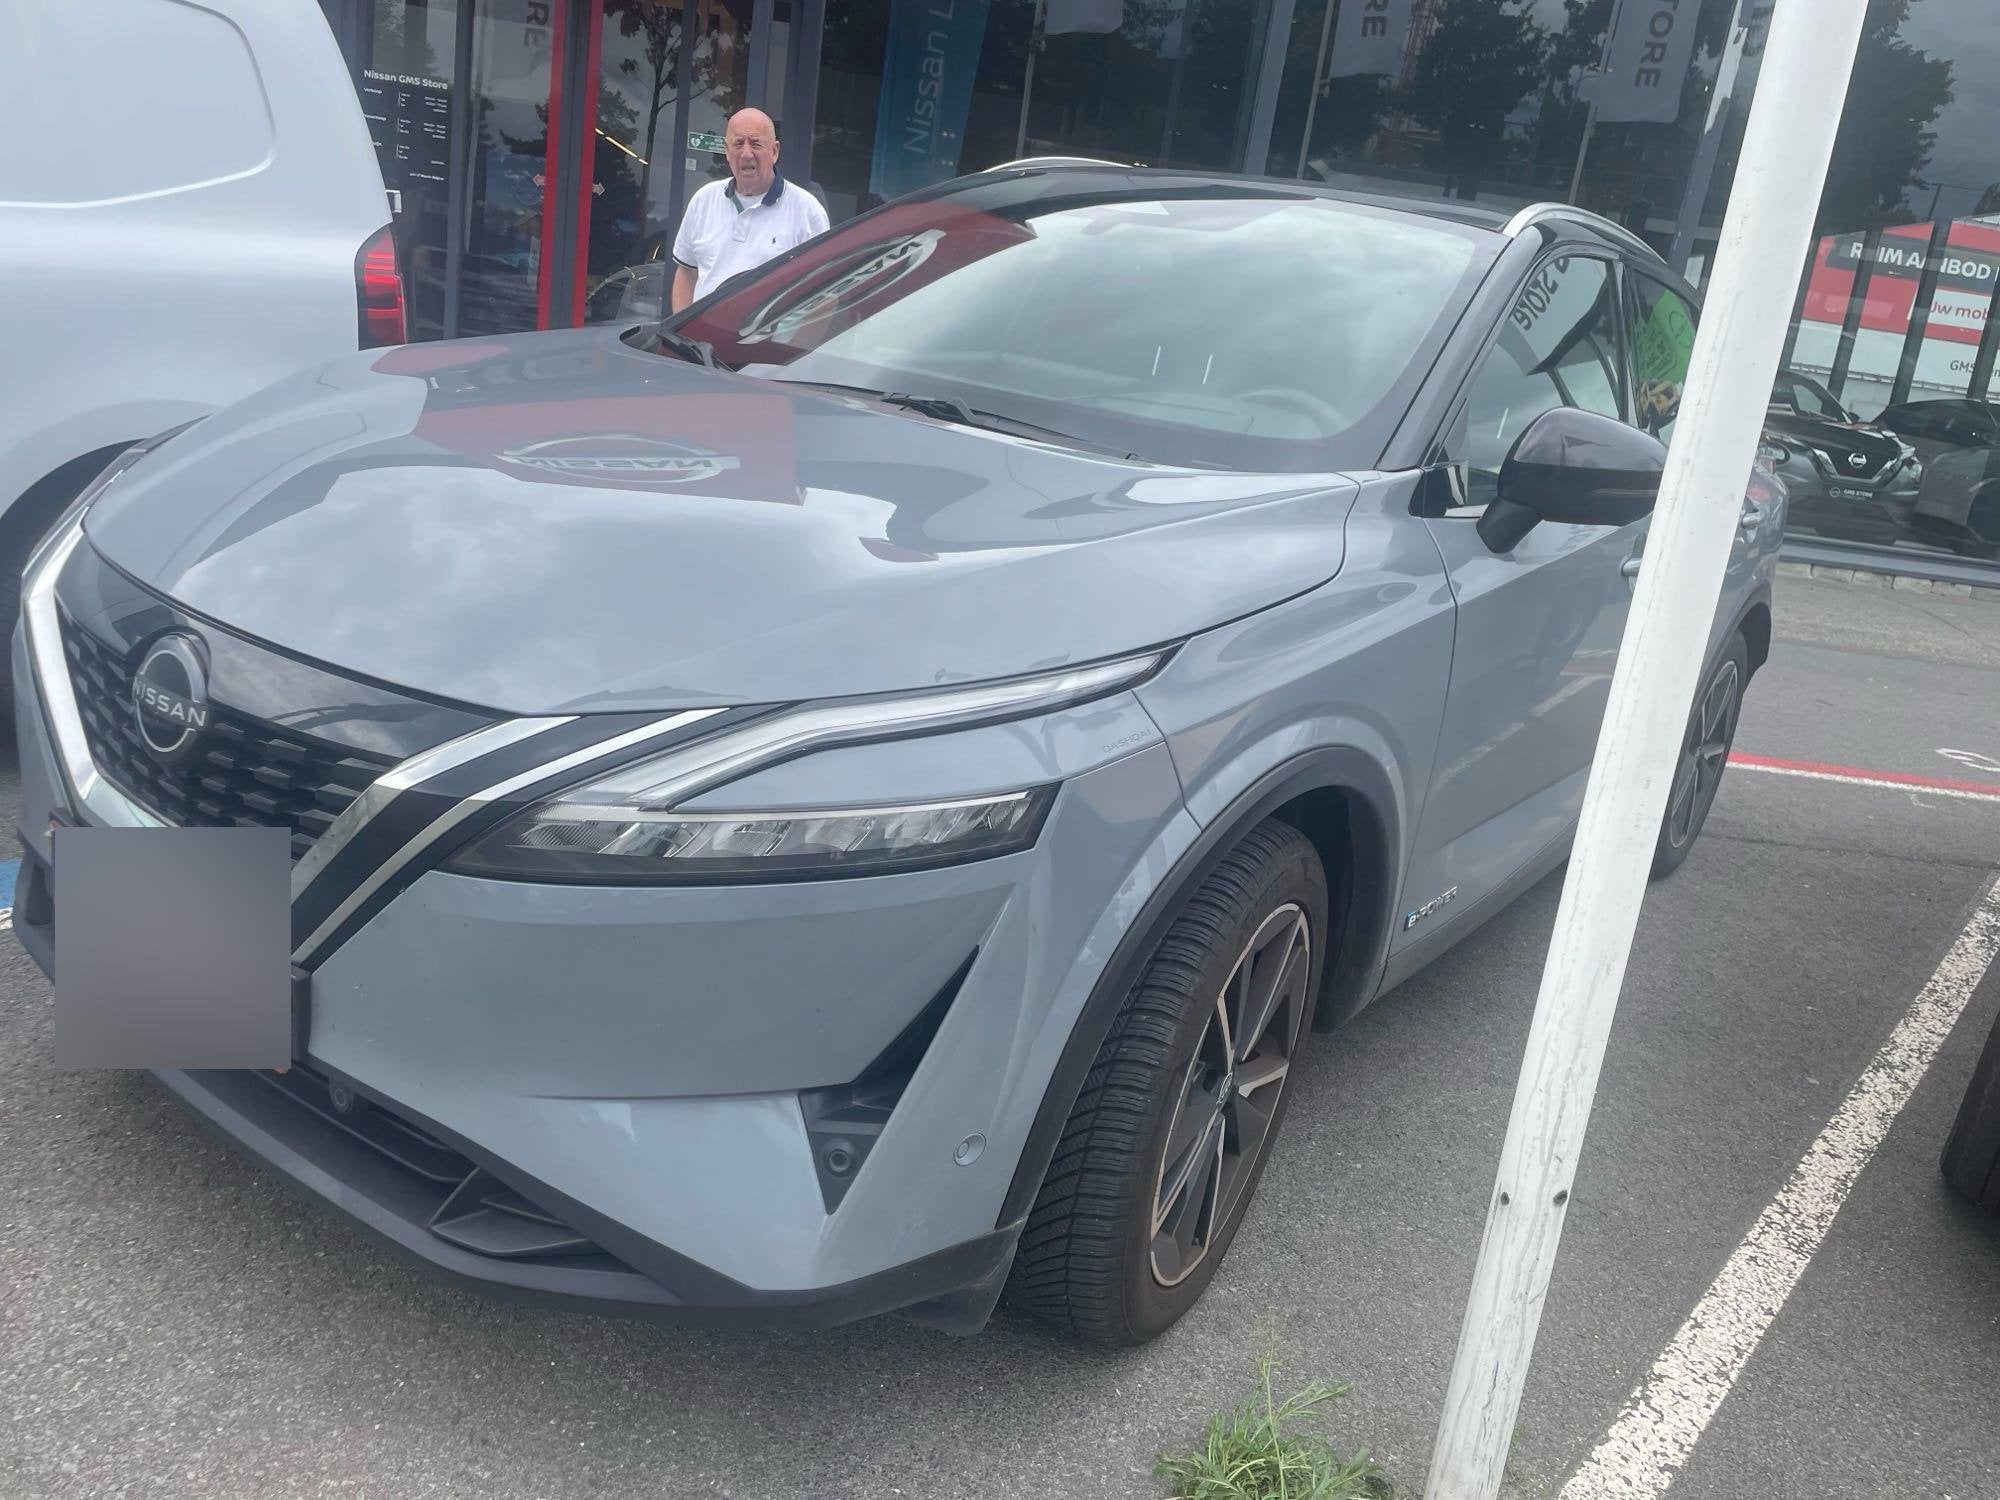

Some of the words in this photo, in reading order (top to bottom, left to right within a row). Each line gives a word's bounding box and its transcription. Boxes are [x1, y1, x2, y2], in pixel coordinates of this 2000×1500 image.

[363, 70, 396, 82] Nissan
[399, 75, 420, 86] GMS
[422, 79, 448, 90] Store
[902, 30, 949, 154] Nissan
[1850, 242, 1903, 266] RIM
[135, 678, 207, 727] NISSAN
